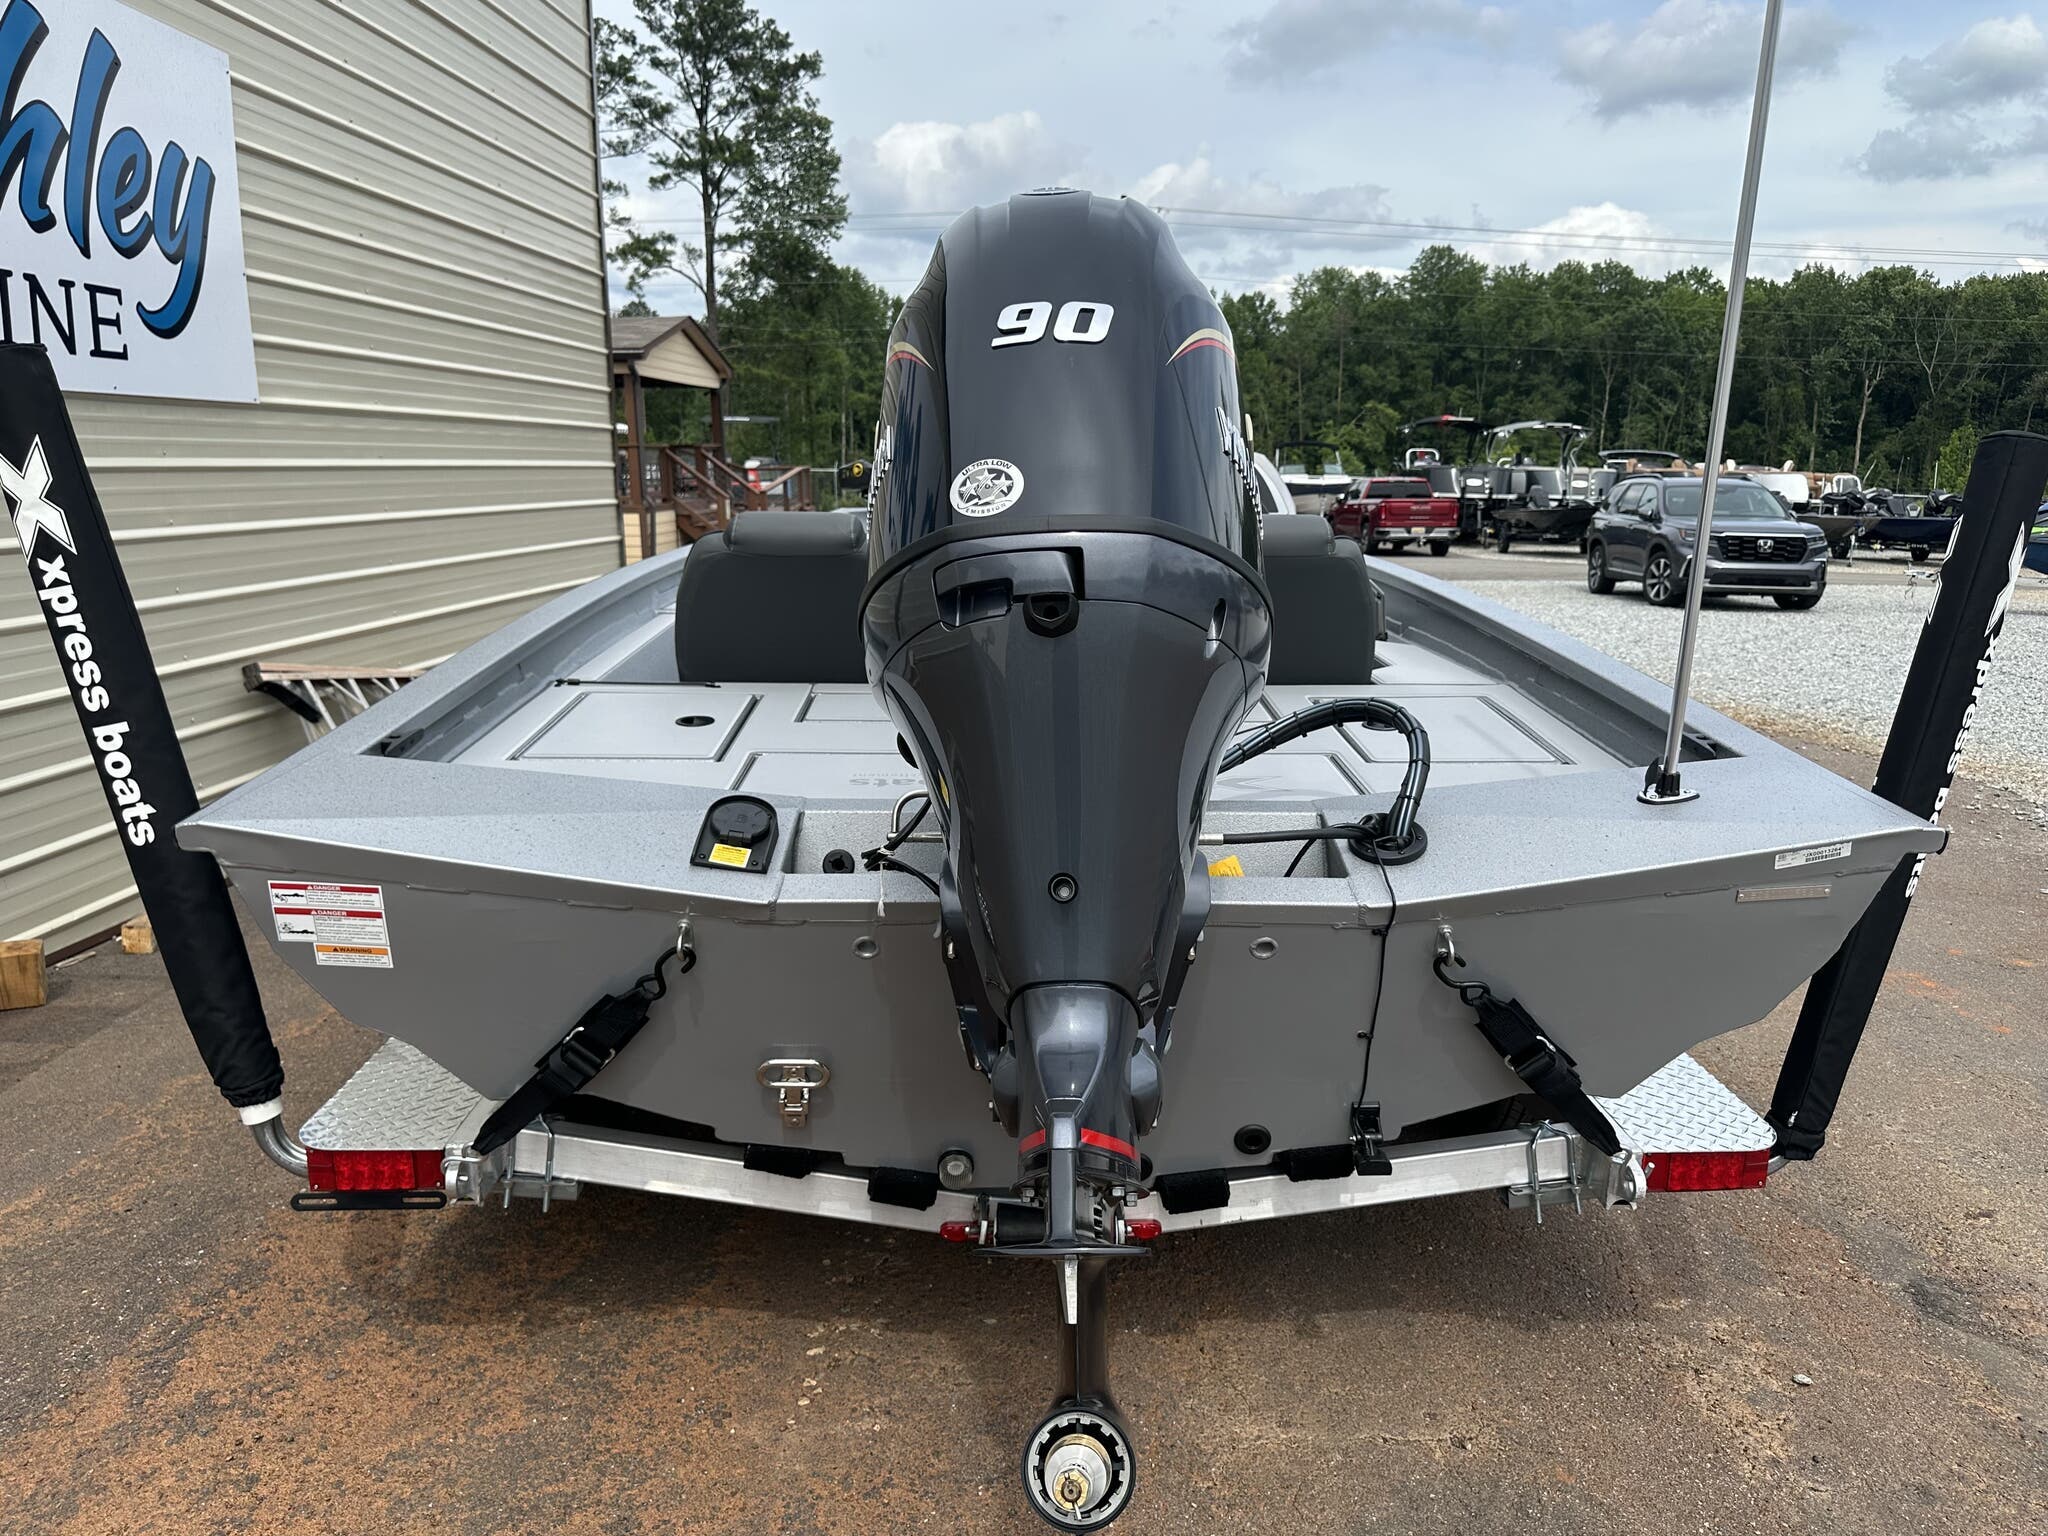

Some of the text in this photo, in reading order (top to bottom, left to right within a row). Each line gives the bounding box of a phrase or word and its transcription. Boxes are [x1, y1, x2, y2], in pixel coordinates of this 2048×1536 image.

[991, 301, 1114, 349] 90
[961, 460, 1013, 477] ULTRA LOW
[965, 503, 1007, 514] EMISSION
[37, 554, 158, 848] xpress boats
